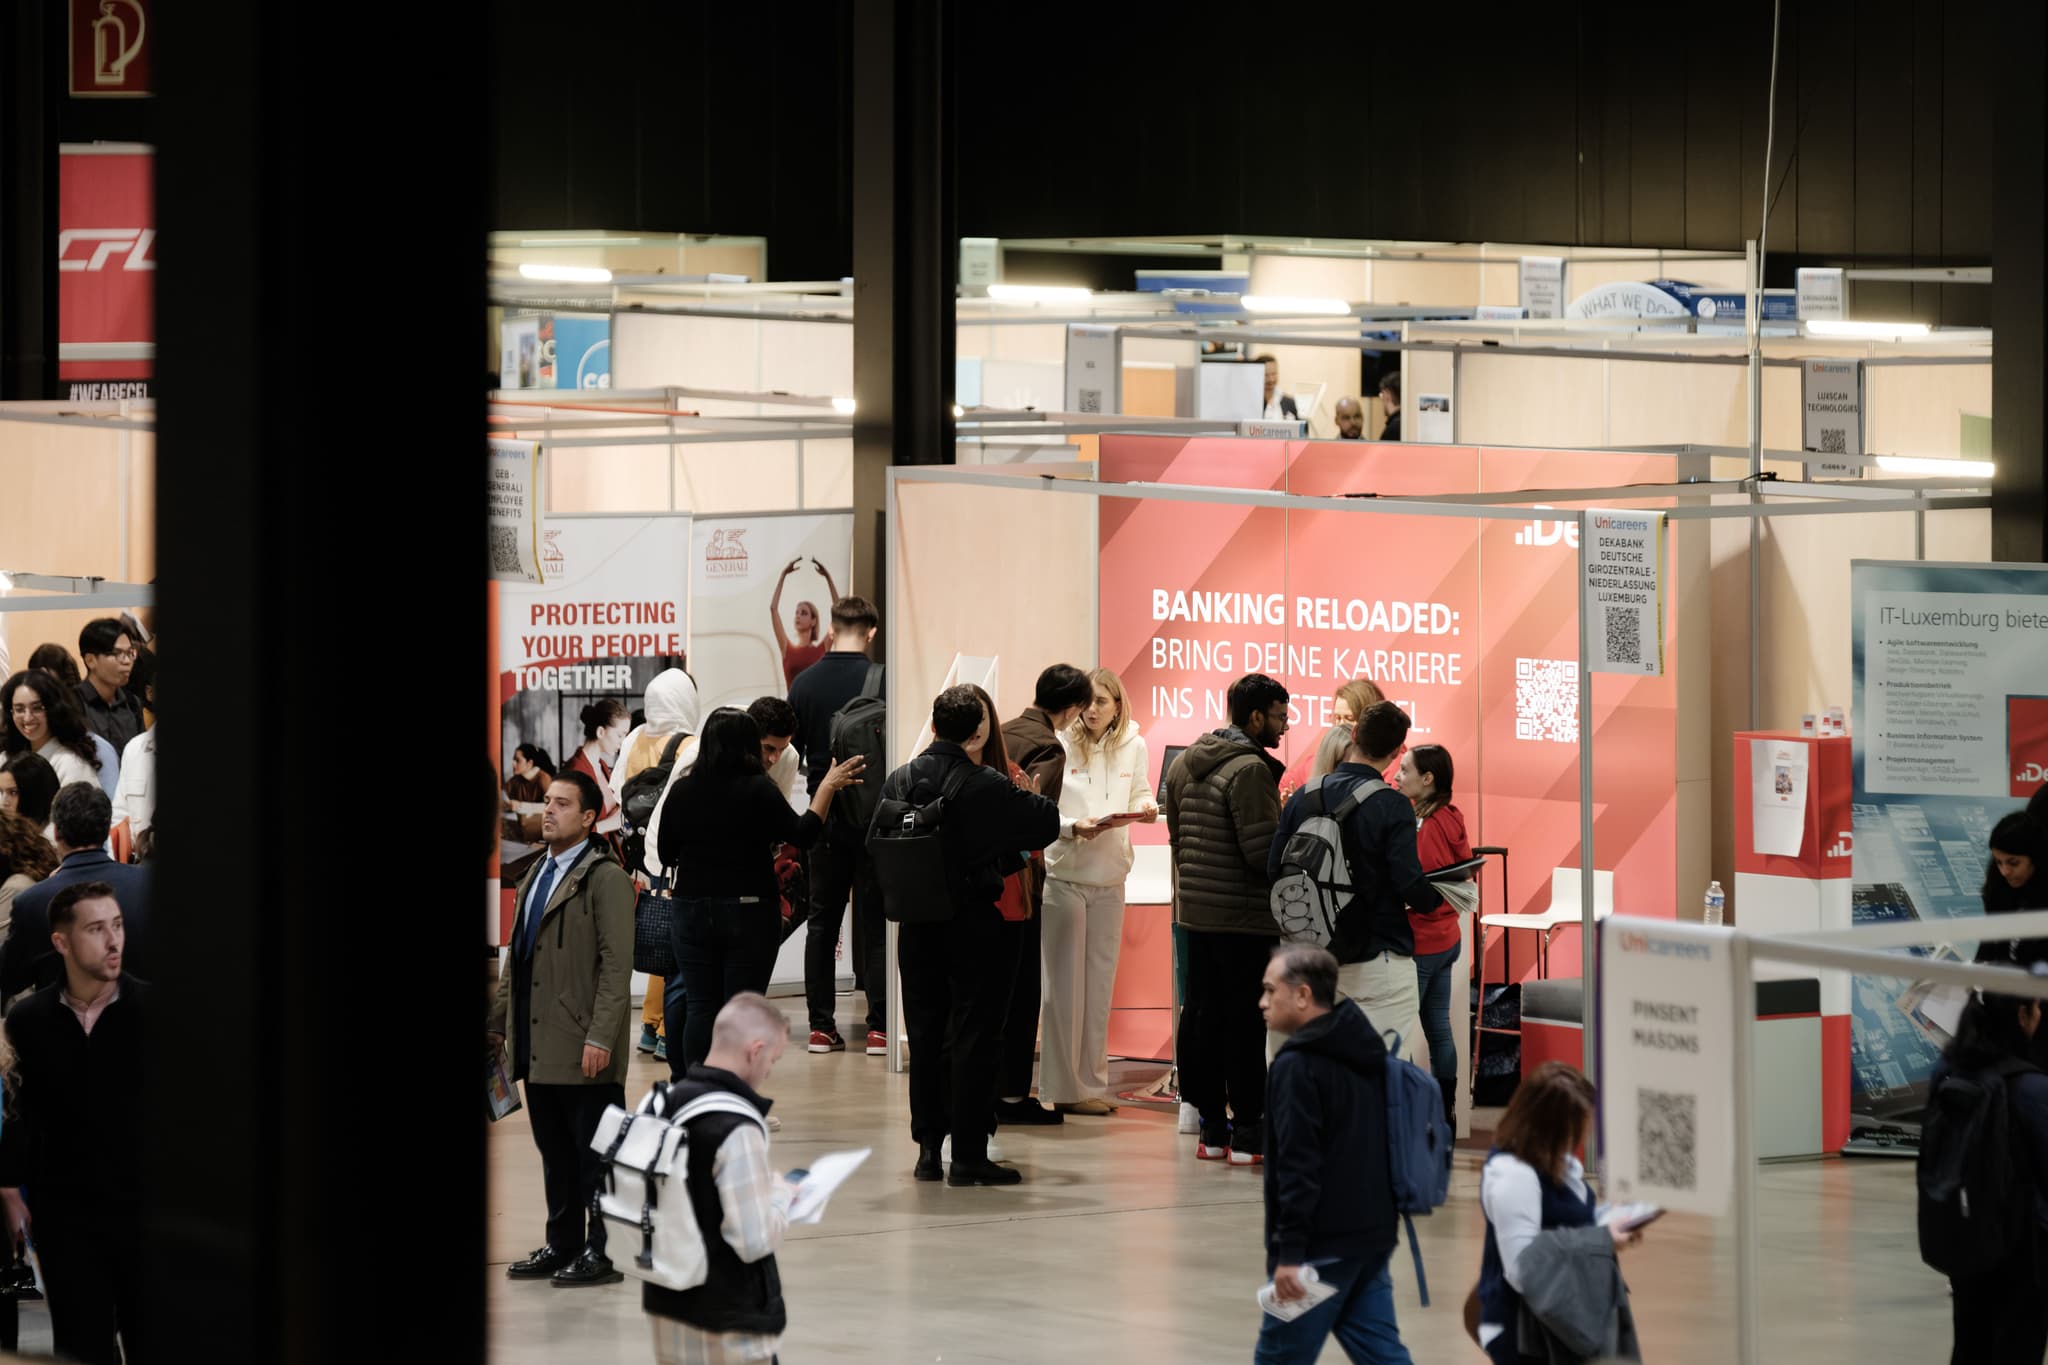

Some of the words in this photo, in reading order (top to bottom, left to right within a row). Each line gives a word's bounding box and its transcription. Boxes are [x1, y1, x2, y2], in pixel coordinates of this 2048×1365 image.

[1580, 293, 1618, 319] WHAT
[1620, 293, 1642, 310] WE
[1807, 403, 1858, 414] TECHNOLOGIES
[1817, 391, 1848, 401] LUXSCAN
[1594, 516, 1648, 531] Unicareers
[1599, 537, 1645, 549] DEKABANK
[706, 561, 748, 573] GENERALI
[1600, 551, 1644, 563] DEUTSCHE
[1588, 563, 1651, 577] GIROZENTRALE
[1588, 578, 1656, 591] NIEDERLASSUNG
[1597, 591, 1648, 604] LUXEMBURG
[530, 601, 676, 626] PROTECTING
[1152, 588, 1285, 625] BANKING
[1296, 596, 1460, 636] RELOADED:
[1880, 606, 1999, 632] IT-Luxemburg
[521, 634, 583, 659] YOUR
[592, 633, 686, 660] PEOPLE,
[1152, 637, 1233, 673] BRING
[1244, 642, 1322, 678] DEINE
[1333, 647, 1462, 685] KARRIERE
[514, 664, 633, 692] TOGETHER
[1152, 686, 1194, 720] INS
[1632, 998, 1700, 1025] PINSENT
[1633, 1027, 1701, 1054] MASONS
